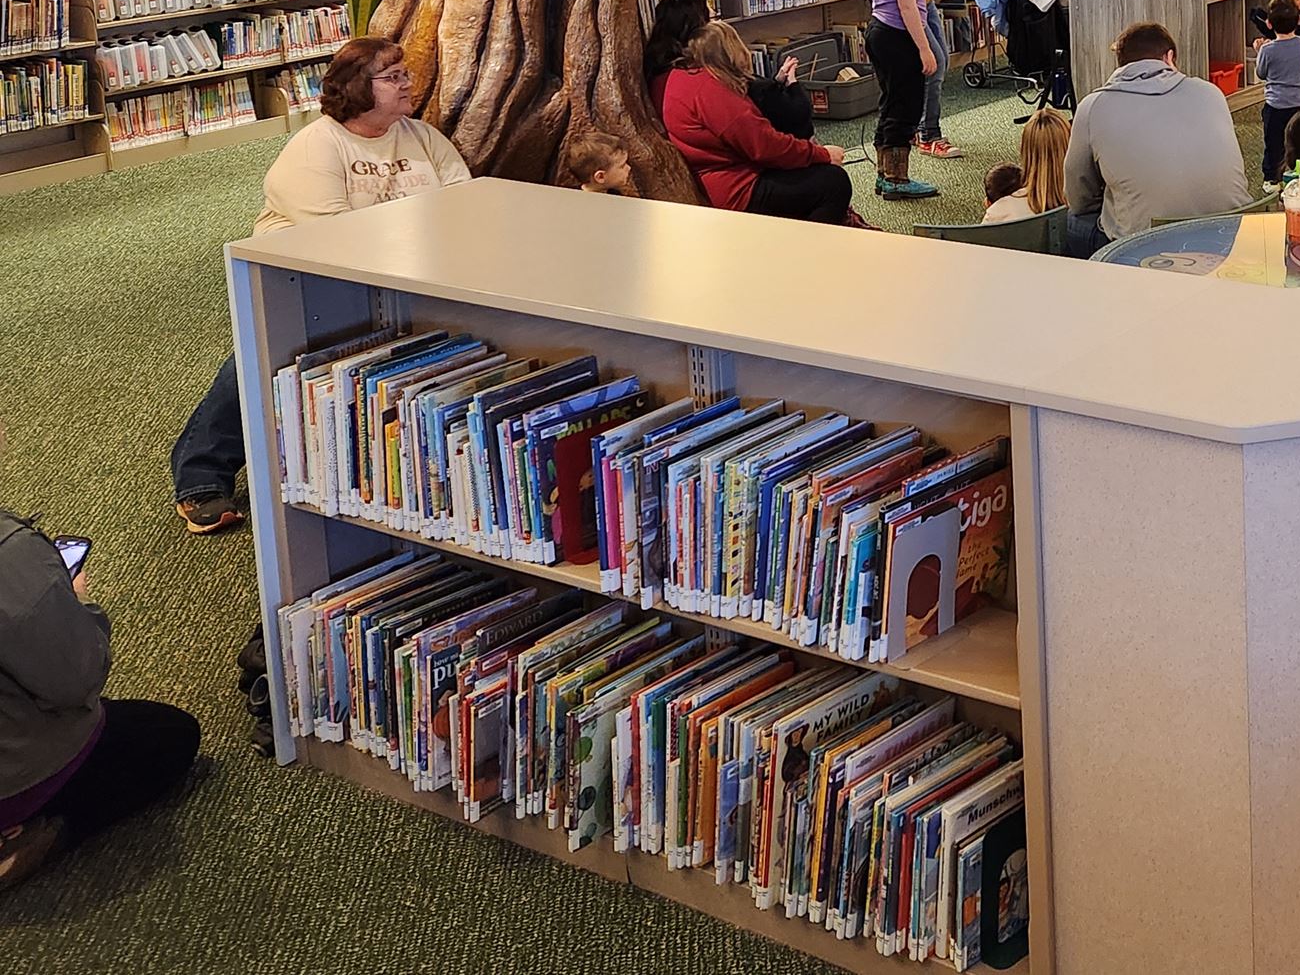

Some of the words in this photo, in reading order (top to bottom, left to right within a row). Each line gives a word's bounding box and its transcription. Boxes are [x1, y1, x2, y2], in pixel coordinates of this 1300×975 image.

[485, 610, 543, 645] EDWARD
[433, 654, 448, 666] how
[813, 712, 833, 733] MY
[837, 693, 870, 719] WILD
[816, 707, 863, 743] FAMILY
